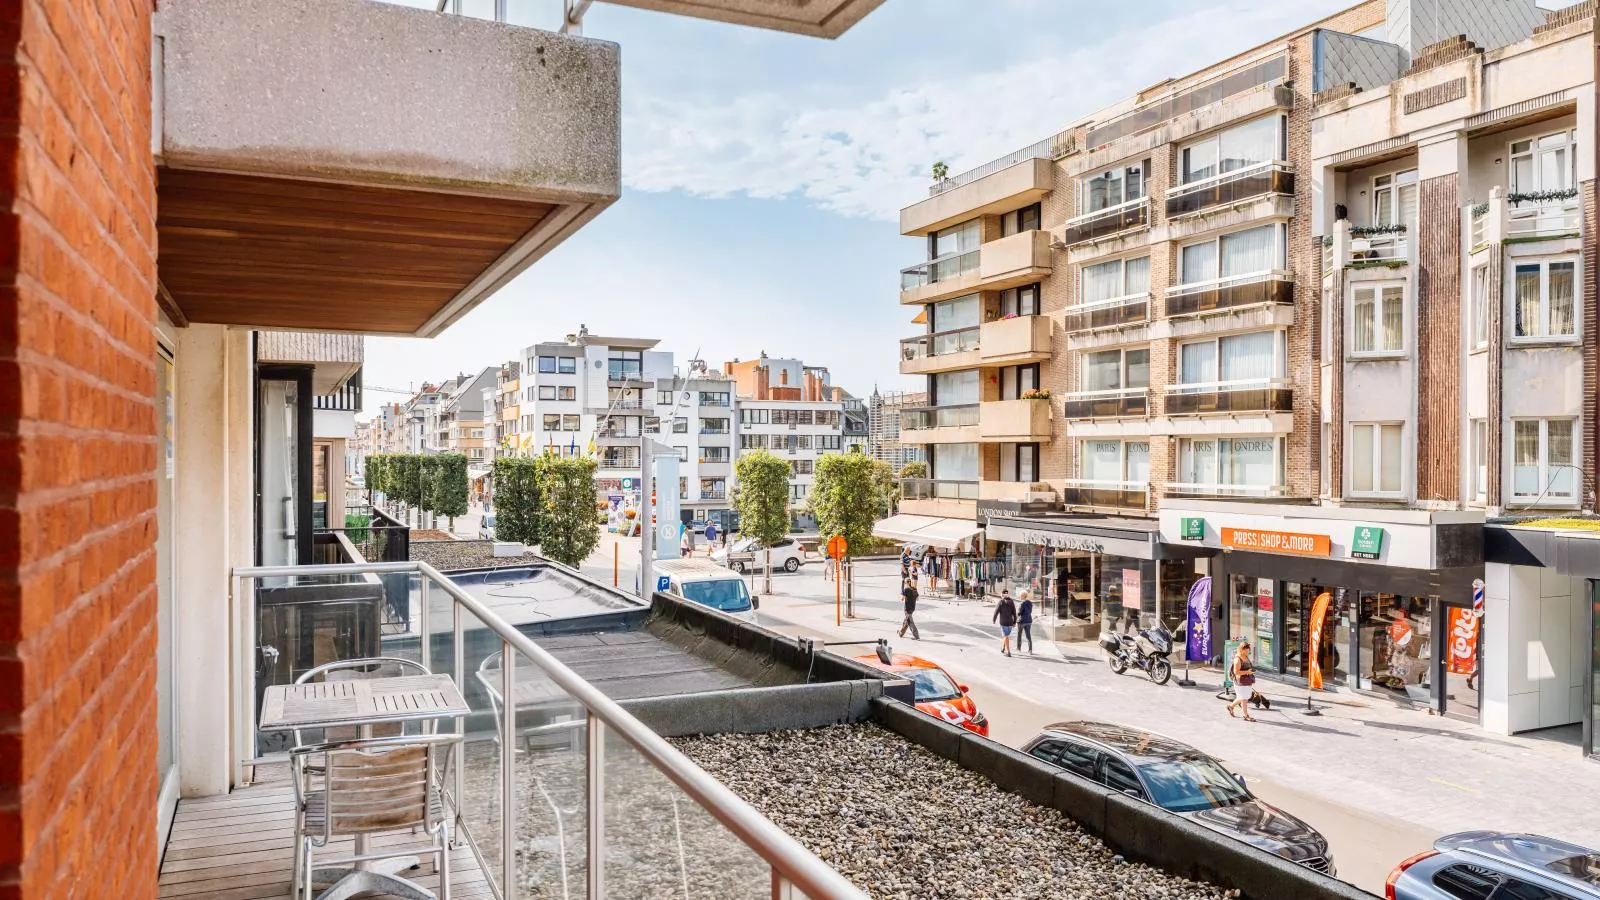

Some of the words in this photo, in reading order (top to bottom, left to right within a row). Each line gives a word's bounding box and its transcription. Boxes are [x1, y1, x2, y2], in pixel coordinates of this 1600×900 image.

[1096, 443, 1117, 453] PARIS
[1234, 439, 1274, 452] ONDRES
[978, 508, 1002, 517] LONDON
[661, 578, 669, 587] P
[1453, 608, 1477, 658] Lotto
